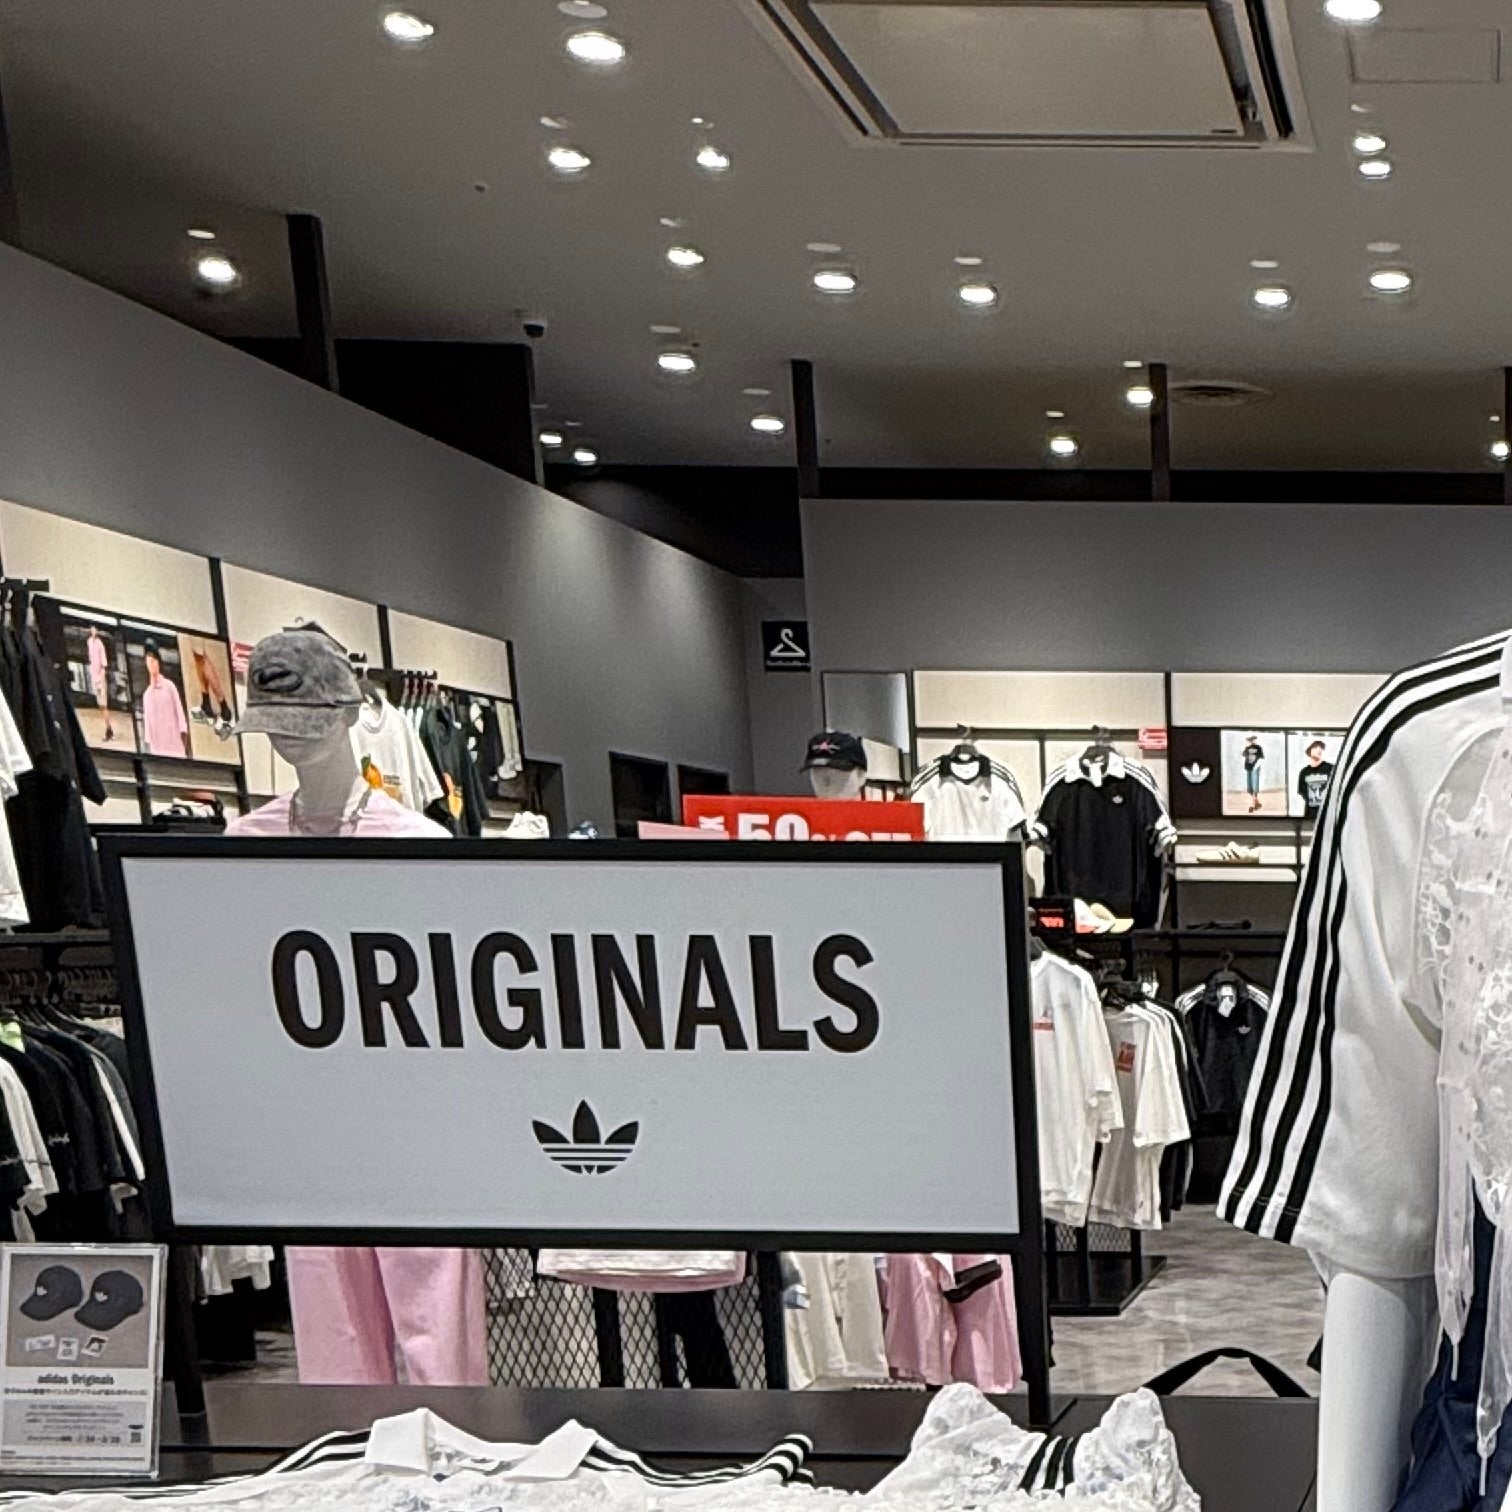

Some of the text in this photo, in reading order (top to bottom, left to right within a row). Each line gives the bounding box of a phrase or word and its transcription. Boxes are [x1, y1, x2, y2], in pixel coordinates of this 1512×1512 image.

[271, 930, 880, 1054] ORIGINALS
[37, 1374, 115, 1387] adidas Originals
